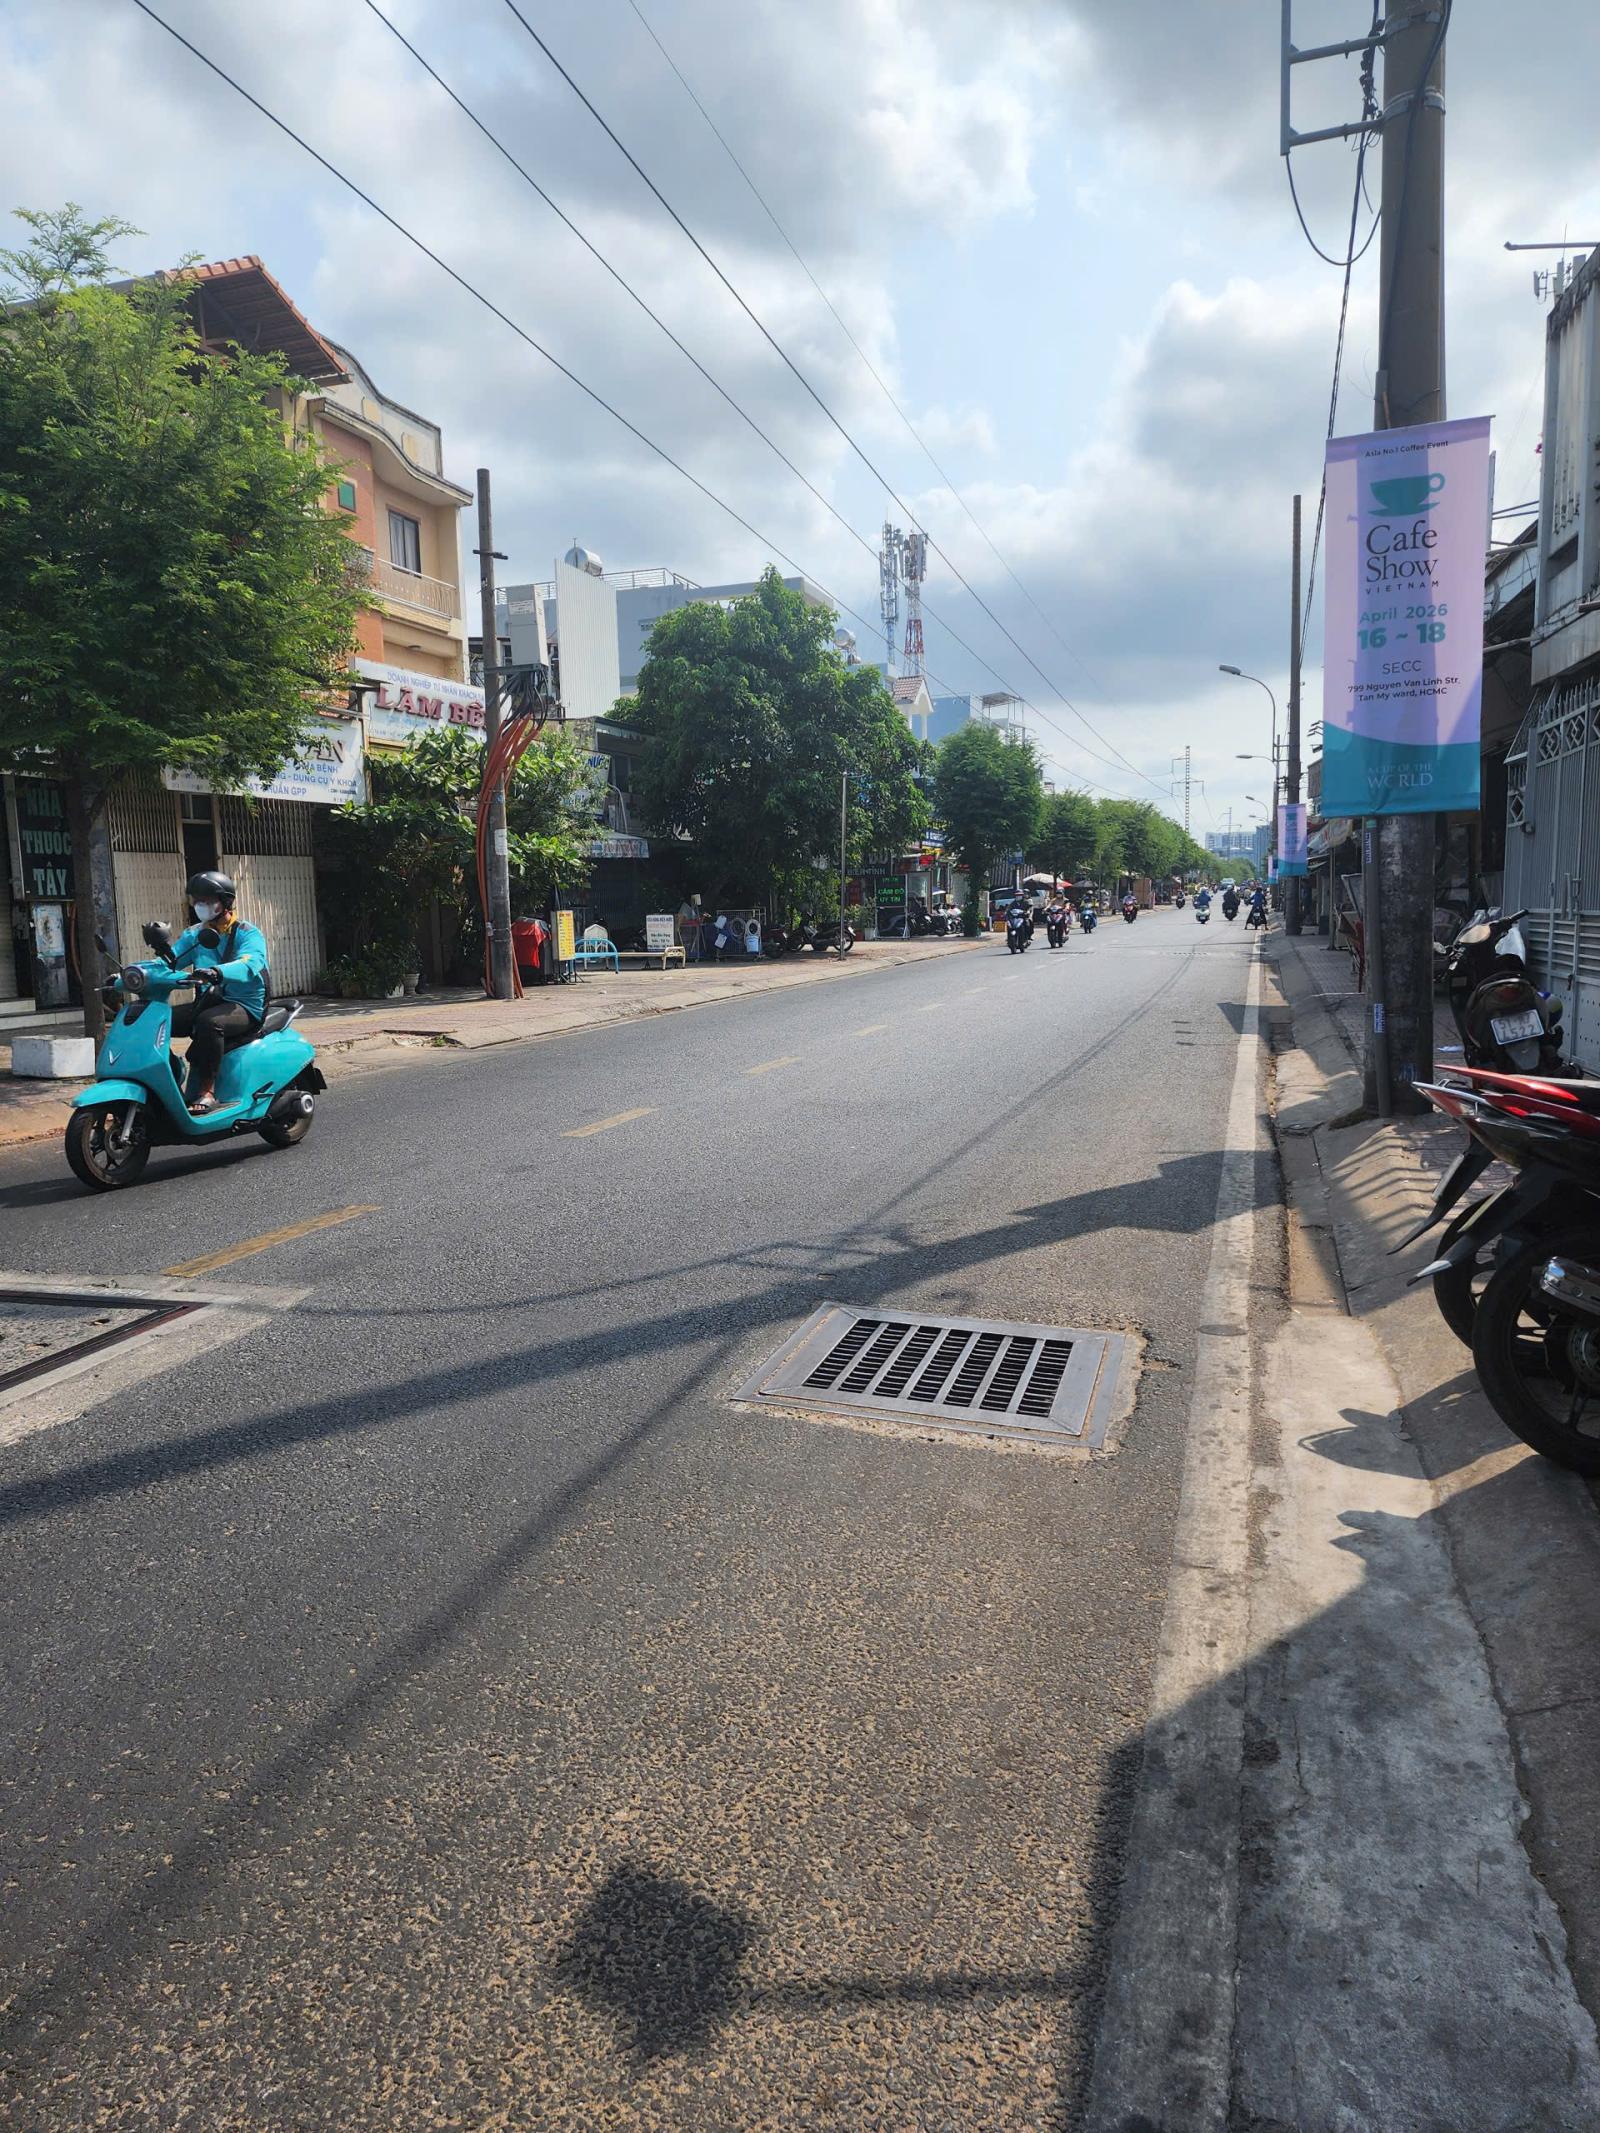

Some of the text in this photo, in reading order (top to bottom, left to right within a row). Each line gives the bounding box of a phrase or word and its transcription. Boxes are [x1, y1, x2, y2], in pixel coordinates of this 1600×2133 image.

[1365, 449, 1381, 457] Asia
[1400, 444, 1426, 453] Coffee
[1427, 441, 1449, 449] Event
[1366, 520, 1438, 555] Cafe
[1366, 555, 1438, 583] Show
[1366, 580, 1439, 595] VIETNAM
[1360, 604, 1448, 624] April 2026
[1357, 627, 1387, 650] 16
[1416, 622, 1446, 644] 18
[1382, 660, 1422, 675] SECC
[1348, 685, 1364, 693] 799
[1366, 681, 1402, 692] Nguyen
[1404, 679, 1421, 688] Van
[1423, 677, 1442, 686] Linh
[1359, 687, 1447, 702] Tan My ward, HCMC
[33, 861, 67, 896] TÂY
